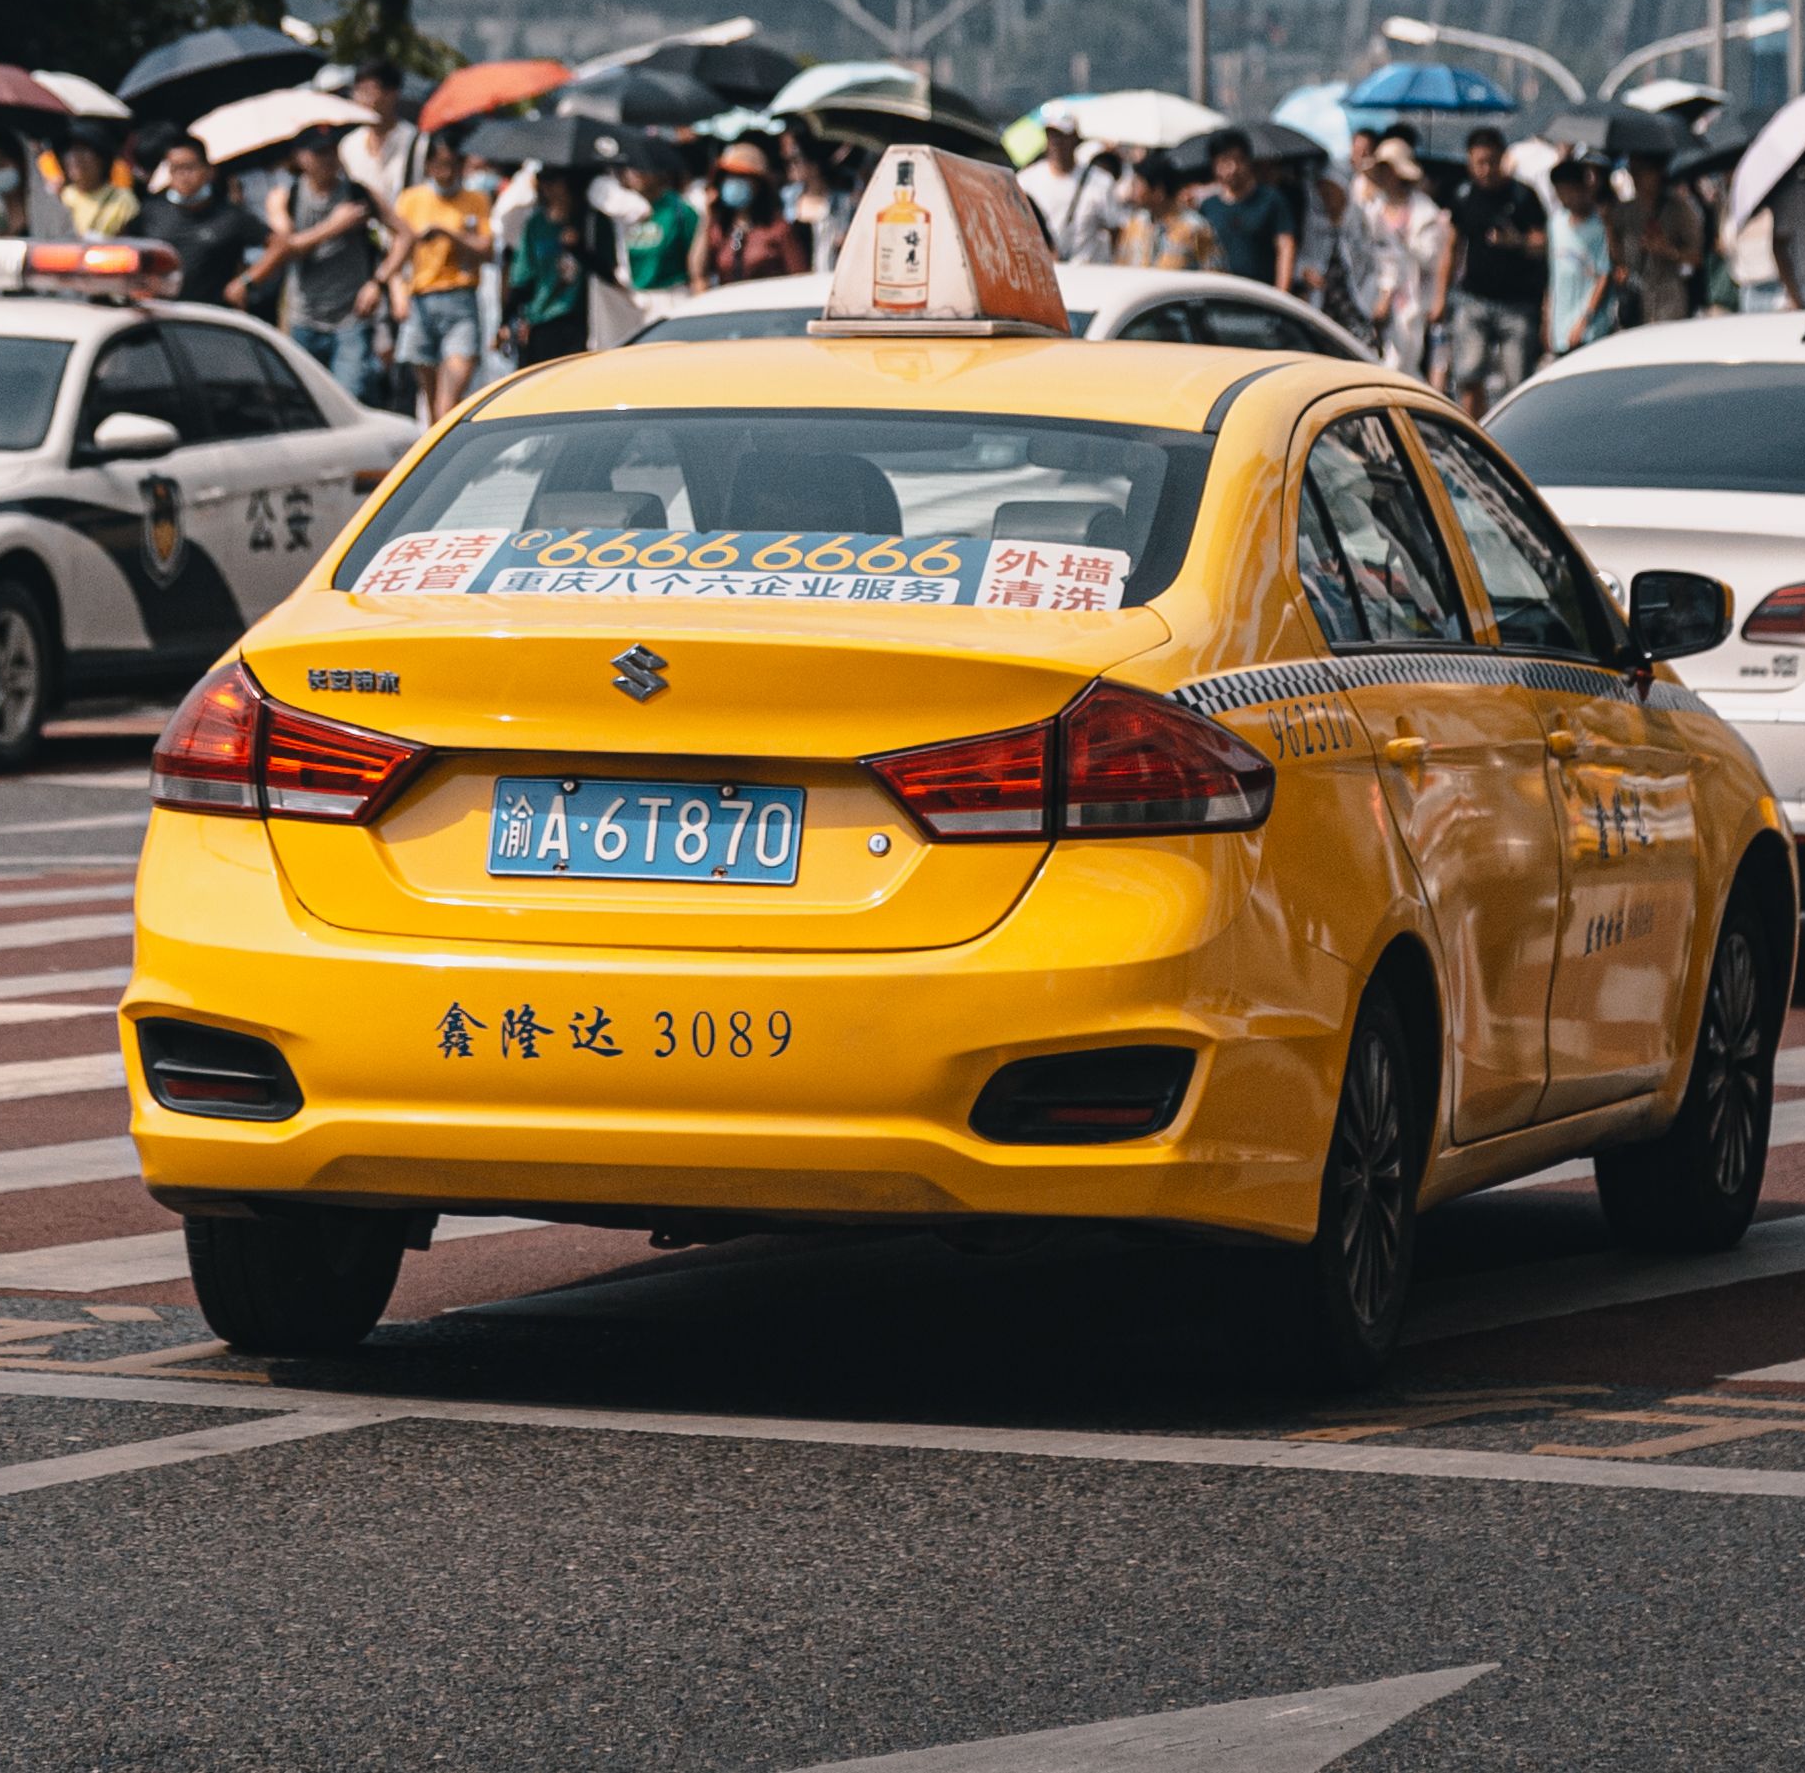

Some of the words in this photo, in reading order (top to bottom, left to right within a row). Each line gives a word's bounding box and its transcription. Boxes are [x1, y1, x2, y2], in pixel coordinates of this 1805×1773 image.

[245, 488, 313, 553] 公安
[384, 532, 498, 566] 保洁
[358, 563, 470, 594] 托管
[995, 548, 1116, 587] 外墙
[498, 570, 947, 605] 重庆八个六企业服务
[987, 578, 1108, 612] 清洗
[435, 1001, 624, 1060] 鑫隆达
[653, 1009, 793, 1059] 3089
